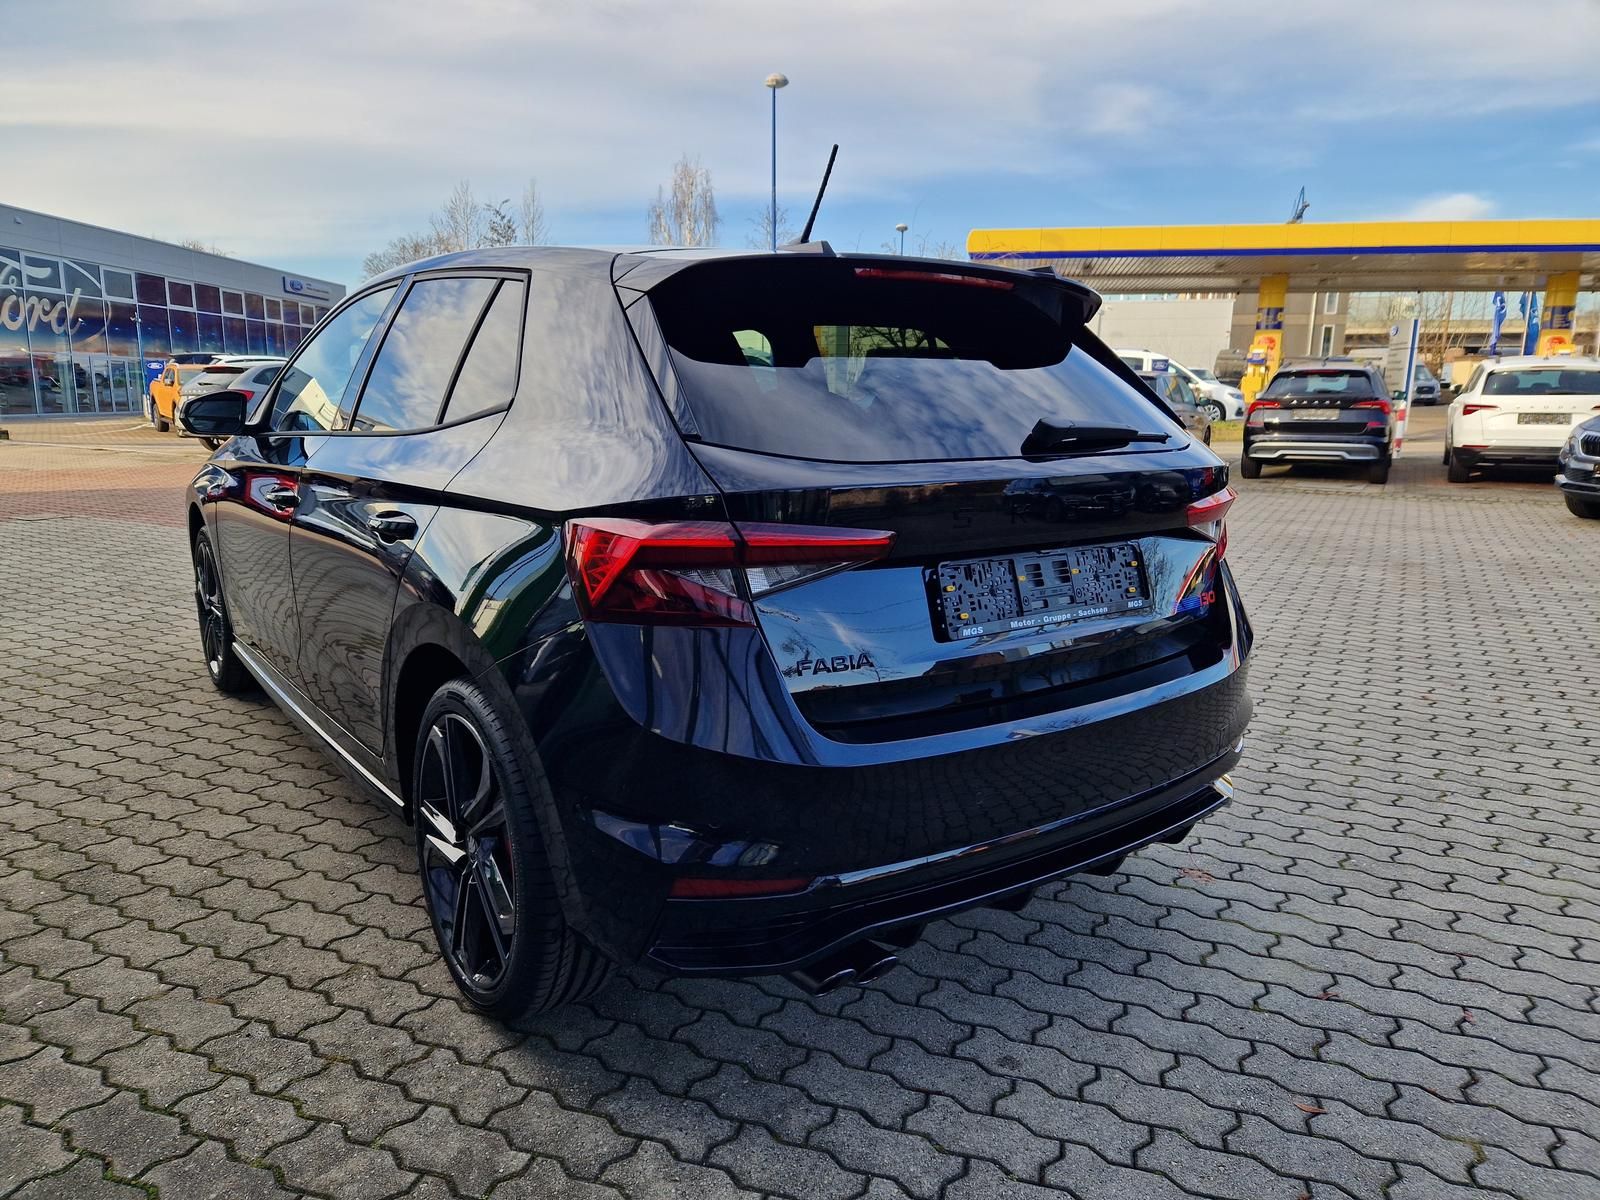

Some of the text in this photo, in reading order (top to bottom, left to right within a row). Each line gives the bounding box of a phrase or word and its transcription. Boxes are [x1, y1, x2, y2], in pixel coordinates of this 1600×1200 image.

[1128, 600, 1143, 608] MGS
[1011, 618, 1035, 628] Motor
[1043, 613, 1071, 623] Gruppe
[1078, 606, 1108, 616] Sachsen
[963, 626, 983, 636] MGS
[796, 653, 875, 677] FABIA
